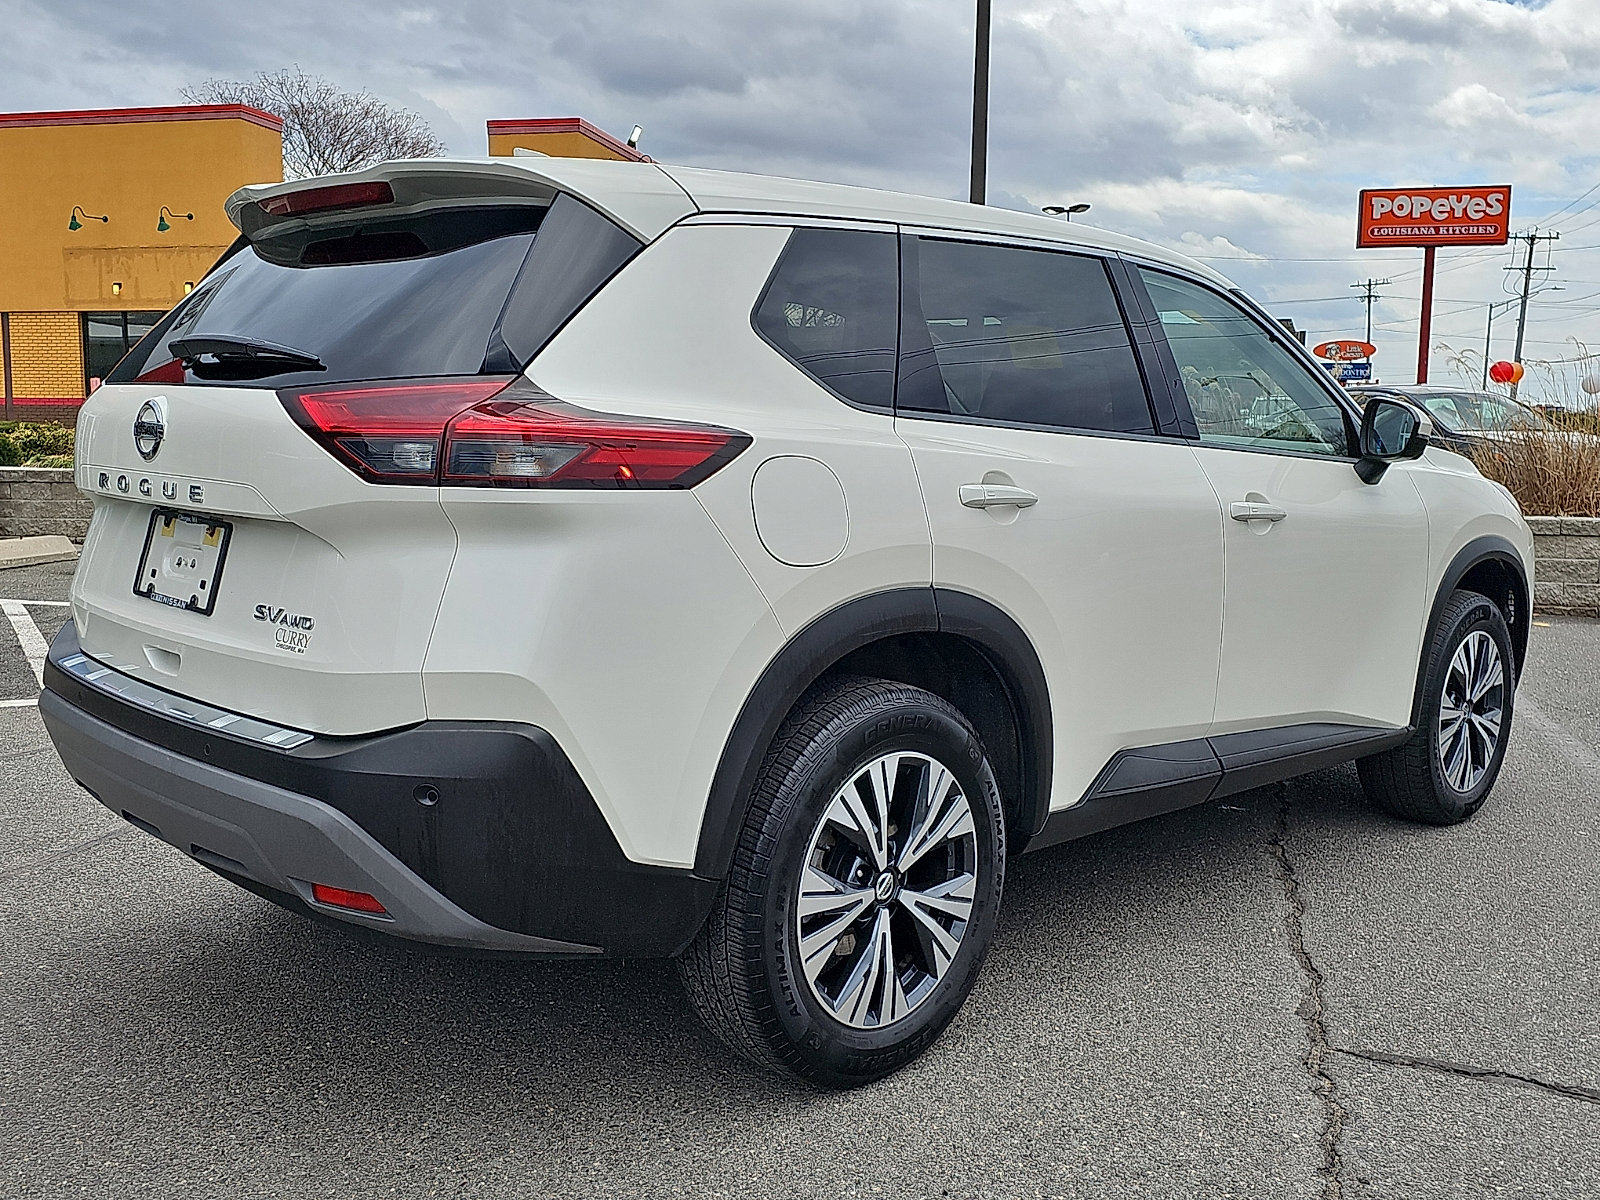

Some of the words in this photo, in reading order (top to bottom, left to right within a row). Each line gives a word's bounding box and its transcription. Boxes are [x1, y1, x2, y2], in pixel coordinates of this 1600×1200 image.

[1373, 226, 1436, 236] LOUISIANA
[1438, 225, 1496, 235] KITCHEN
[98, 472, 205, 504] ROGUE
[275, 627, 312, 649] CURRY
[774, 920, 802, 1017] ALTIMAX
